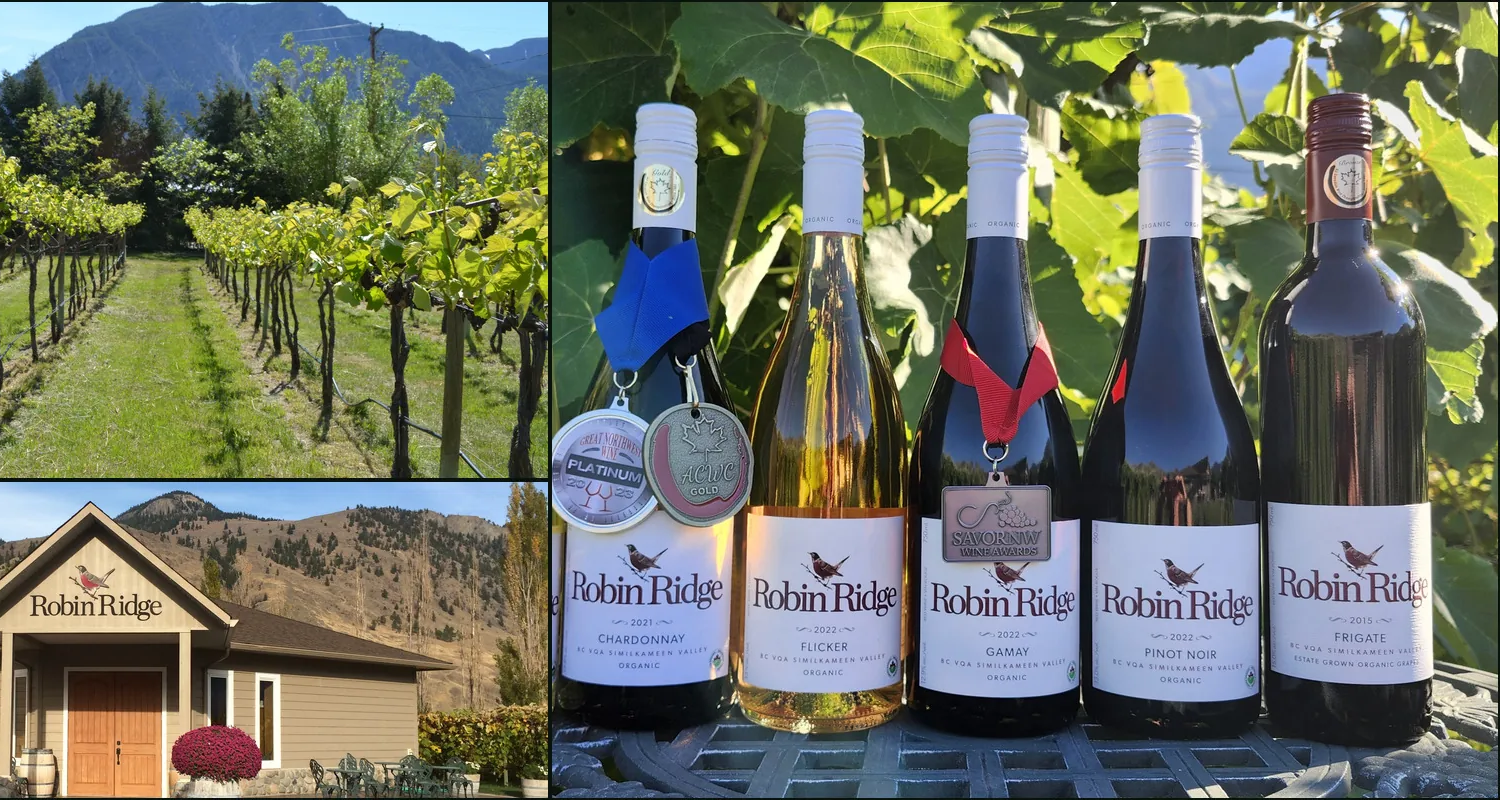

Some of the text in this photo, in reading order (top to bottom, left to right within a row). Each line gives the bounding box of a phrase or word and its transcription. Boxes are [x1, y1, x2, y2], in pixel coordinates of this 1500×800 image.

[805, 216, 834, 224] ORGANIC
[1141, 221, 1171, 230] ORGANIC
[580, 432, 604, 446] GREAT
[601, 445, 619, 460] WINE
[567, 459, 642, 484] PLATINUM
[681, 462, 736, 485] ACWC
[690, 486, 719, 496] GOLD
[960, 547, 1038, 557] WINE AWARDS
[572, 570, 647, 605] Robin
[647, 573, 723, 610] Ridge
[1278, 566, 1364, 602] Robin
[1365, 571, 1428, 608] Ridge
[753, 578, 830, 612] Robin
[831, 580, 897, 617] Ridge
[931, 582, 1012, 617] Robin
[1013, 585, 1075, 621] Ridge
[30, 594, 162, 621] Robin Ridge
[1102, 583, 1184, 620] Robin
[1186, 589, 1254, 626] Ridge
[630, 619, 653, 627] 2021
[1350, 616, 1373, 624] 2015
[814, 626, 837, 634] 2022
[997, 631, 1020, 639] 2022
[598, 633, 685, 645] CHARDONNAY
[1170, 633, 1193, 641] 2022
[1334, 632, 1387, 643] FRIGATE
[678, 647, 707, 655] VALLEY
[801, 642, 848, 652] FLICKER
[986, 647, 1030, 657] GAMAY
[1290, 642, 1300, 650] BC
[1327, 647, 1394, 655] SIMILKAMEEN
[860, 653, 885, 662] VALLEY
[1144, 648, 1217, 660] PINOT NOIR
[1042, 658, 1066, 667] VALLEY
[1127, 661, 1144, 669] VQA
[1149, 664, 1213, 672] SIMILKAMEEN
[1217, 663, 1243, 671] VALLEY
[1294, 655, 1320, 665] ESTATE
[1322, 658, 1354, 667] GROWN
